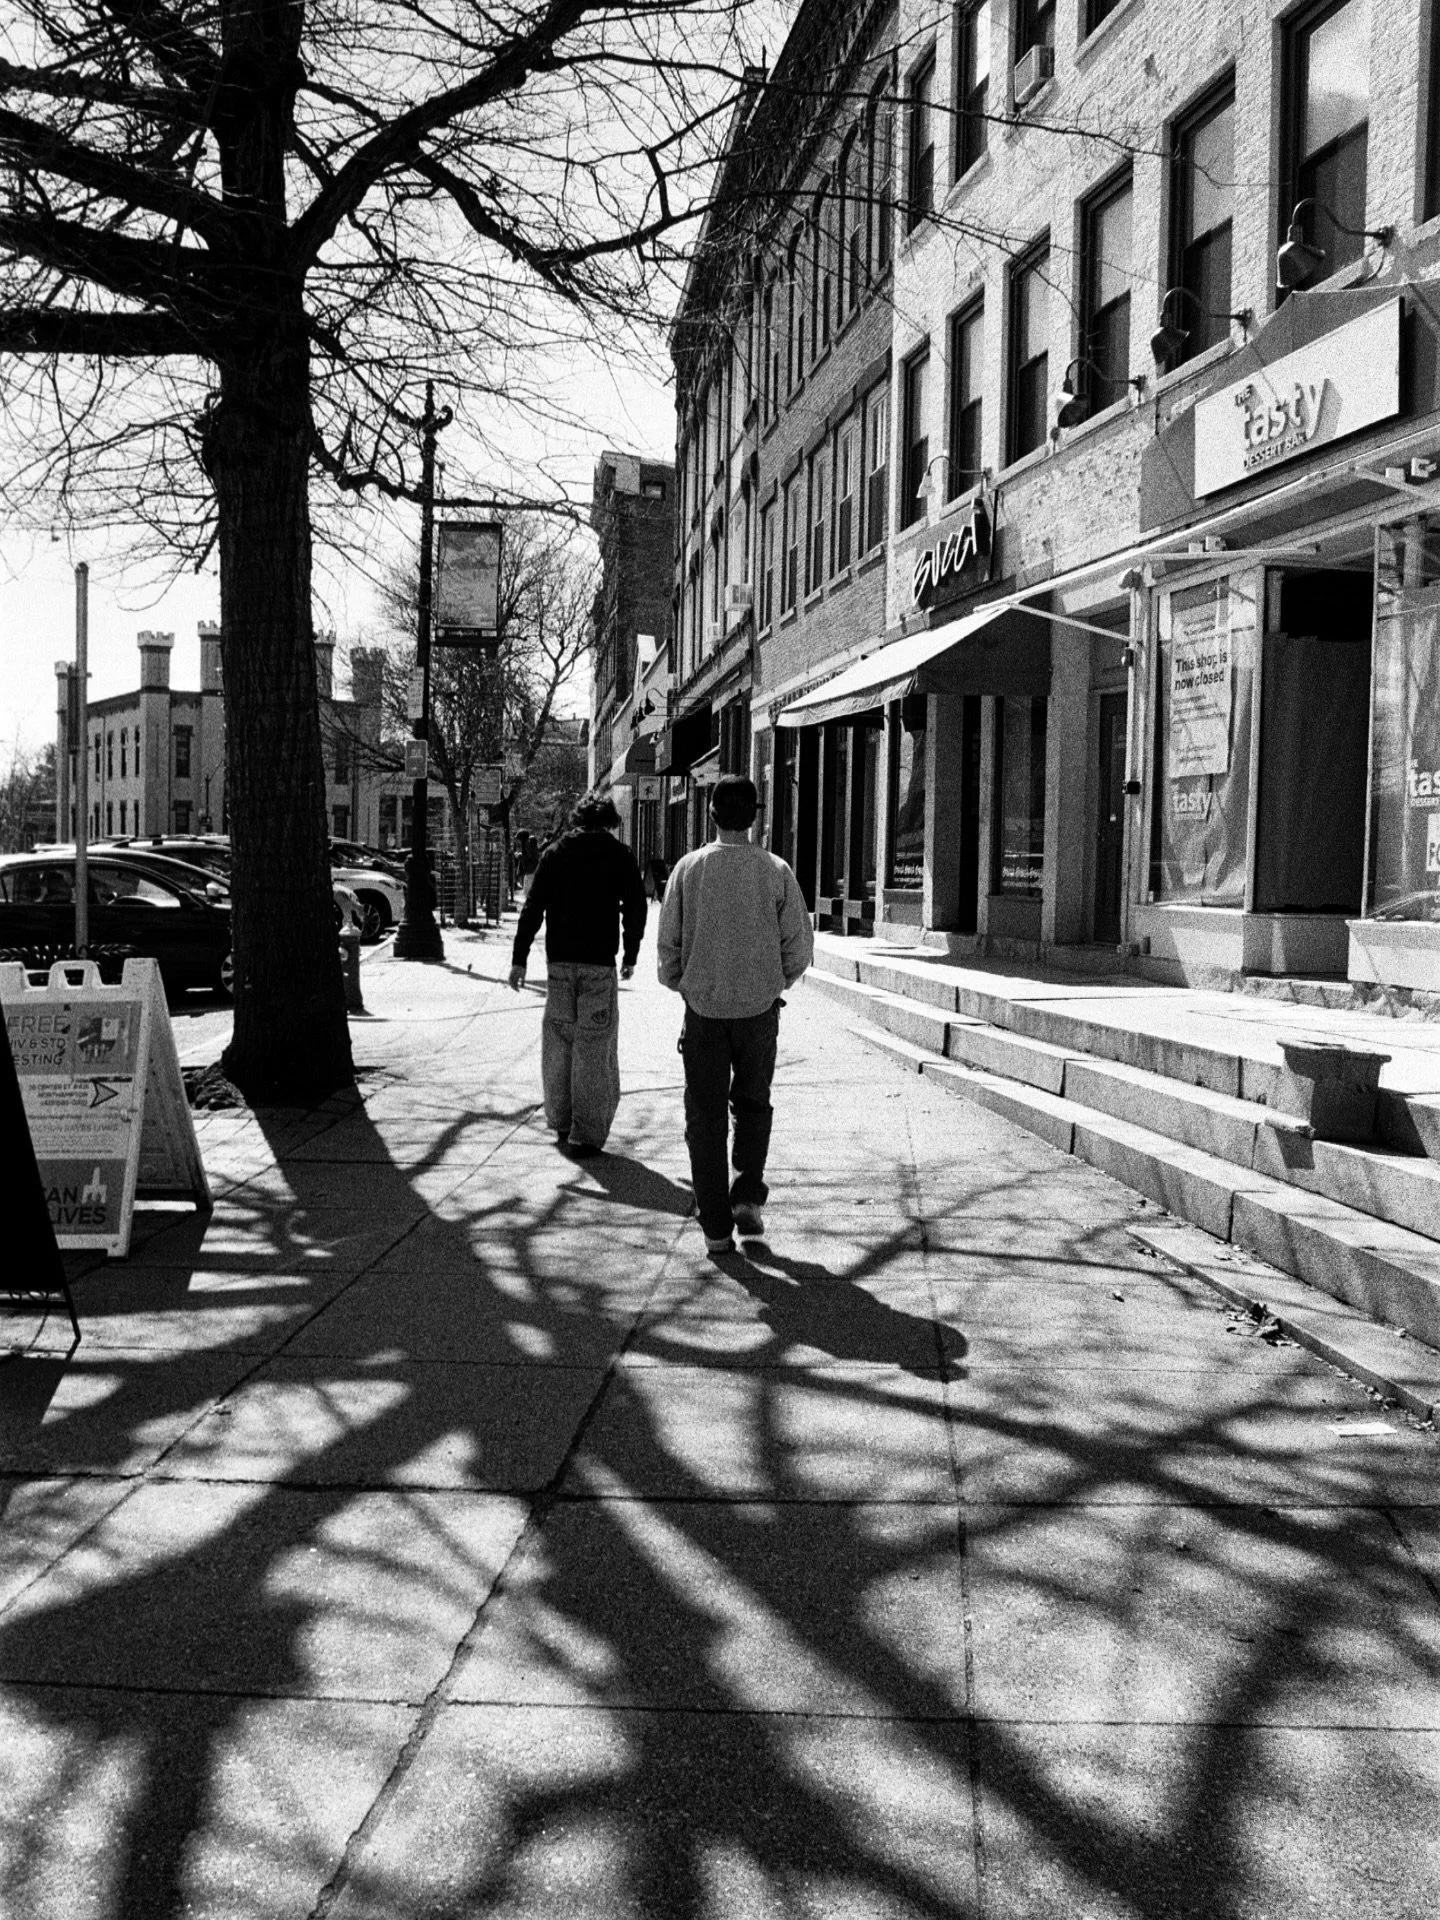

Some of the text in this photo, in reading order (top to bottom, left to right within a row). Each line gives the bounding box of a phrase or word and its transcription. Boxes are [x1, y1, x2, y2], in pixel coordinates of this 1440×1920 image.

[1242, 431, 1307, 469] DESSERT BAR
[1176, 648, 1228, 673] This shop is
[1175, 667, 1225, 690] now closed
[7, 1015, 69, 1034] FREE
[29, 1039, 38, 1049] &
[40, 1038, 66, 1049] STD
[12, 1053, 63, 1066] ESTING
